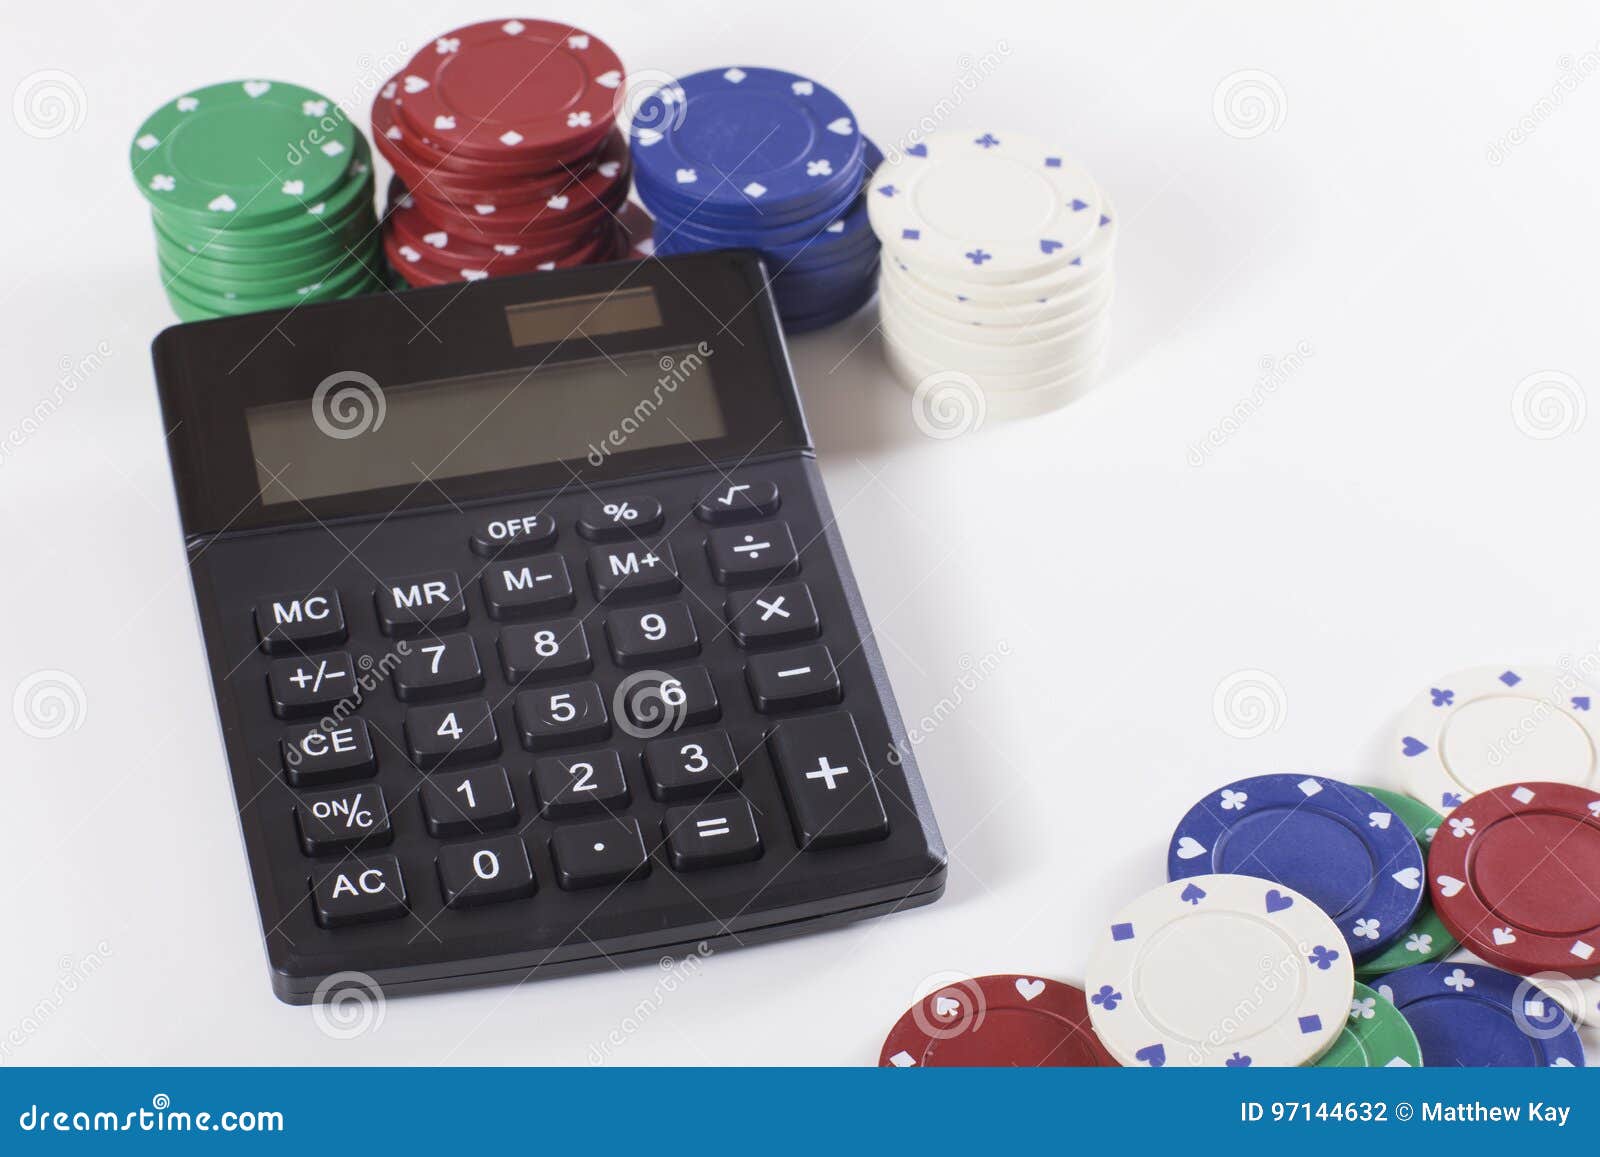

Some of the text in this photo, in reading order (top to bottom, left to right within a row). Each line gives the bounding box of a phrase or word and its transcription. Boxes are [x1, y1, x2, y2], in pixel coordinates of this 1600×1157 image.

[604, 503, 637, 521] %
[488, 515, 536, 538] OFF
[609, 553, 660, 576] M+
[503, 568, 552, 590] M-
[393, 582, 450, 608] MR
[273, 597, 330, 623] MC
[641, 614, 666, 640] 9
[535, 631, 558, 656] 8
[422, 645, 446, 673] 7
[289, 660, 346, 692] +/-
[660, 678, 686, 706] 6
[551, 694, 576, 721] 5
[437, 713, 463, 739] 4
[302, 728, 357, 755] CE
[681, 744, 708, 772] 3
[570, 763, 598, 791] 2
[457, 780, 476, 807] 1
[313, 794, 373, 828] ON/C
[473, 850, 499, 879] 0
[332, 869, 386, 898] AC
